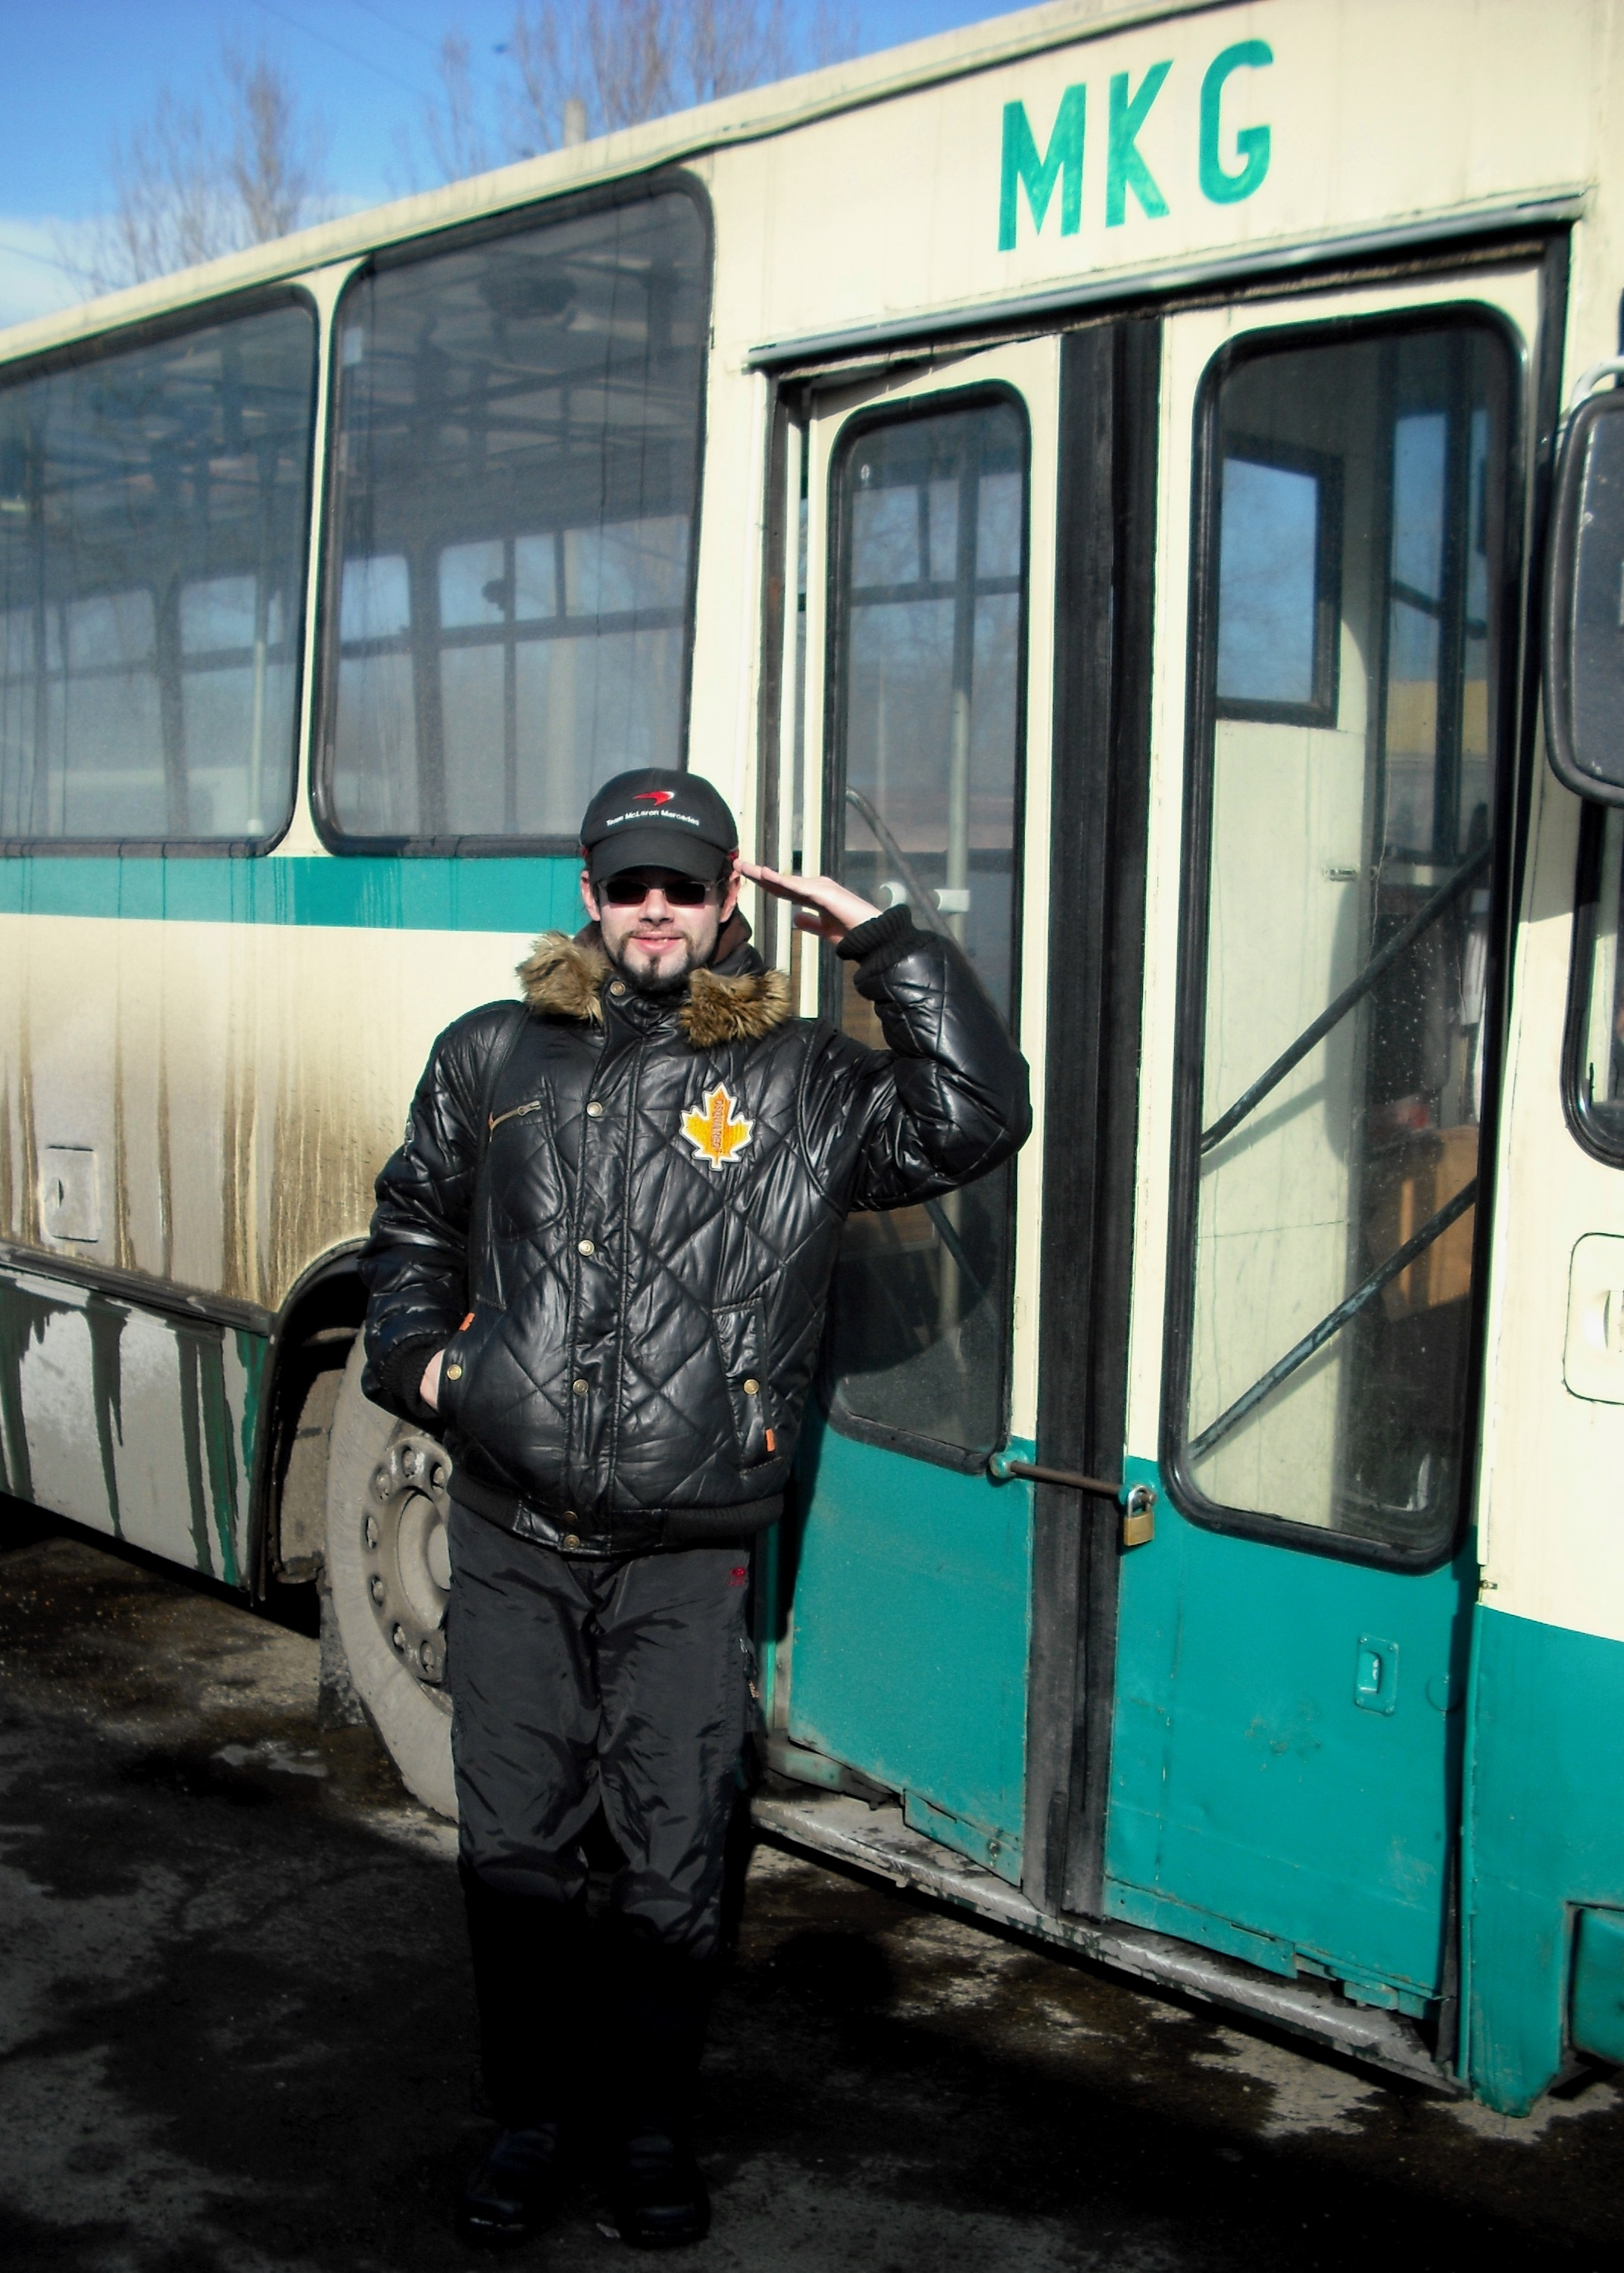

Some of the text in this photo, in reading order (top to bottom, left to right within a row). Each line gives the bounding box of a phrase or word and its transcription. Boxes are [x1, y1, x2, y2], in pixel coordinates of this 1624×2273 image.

[998, 39, 1274, 252] MKG
[606, 809, 700, 826] Team McLaren Mercedes
